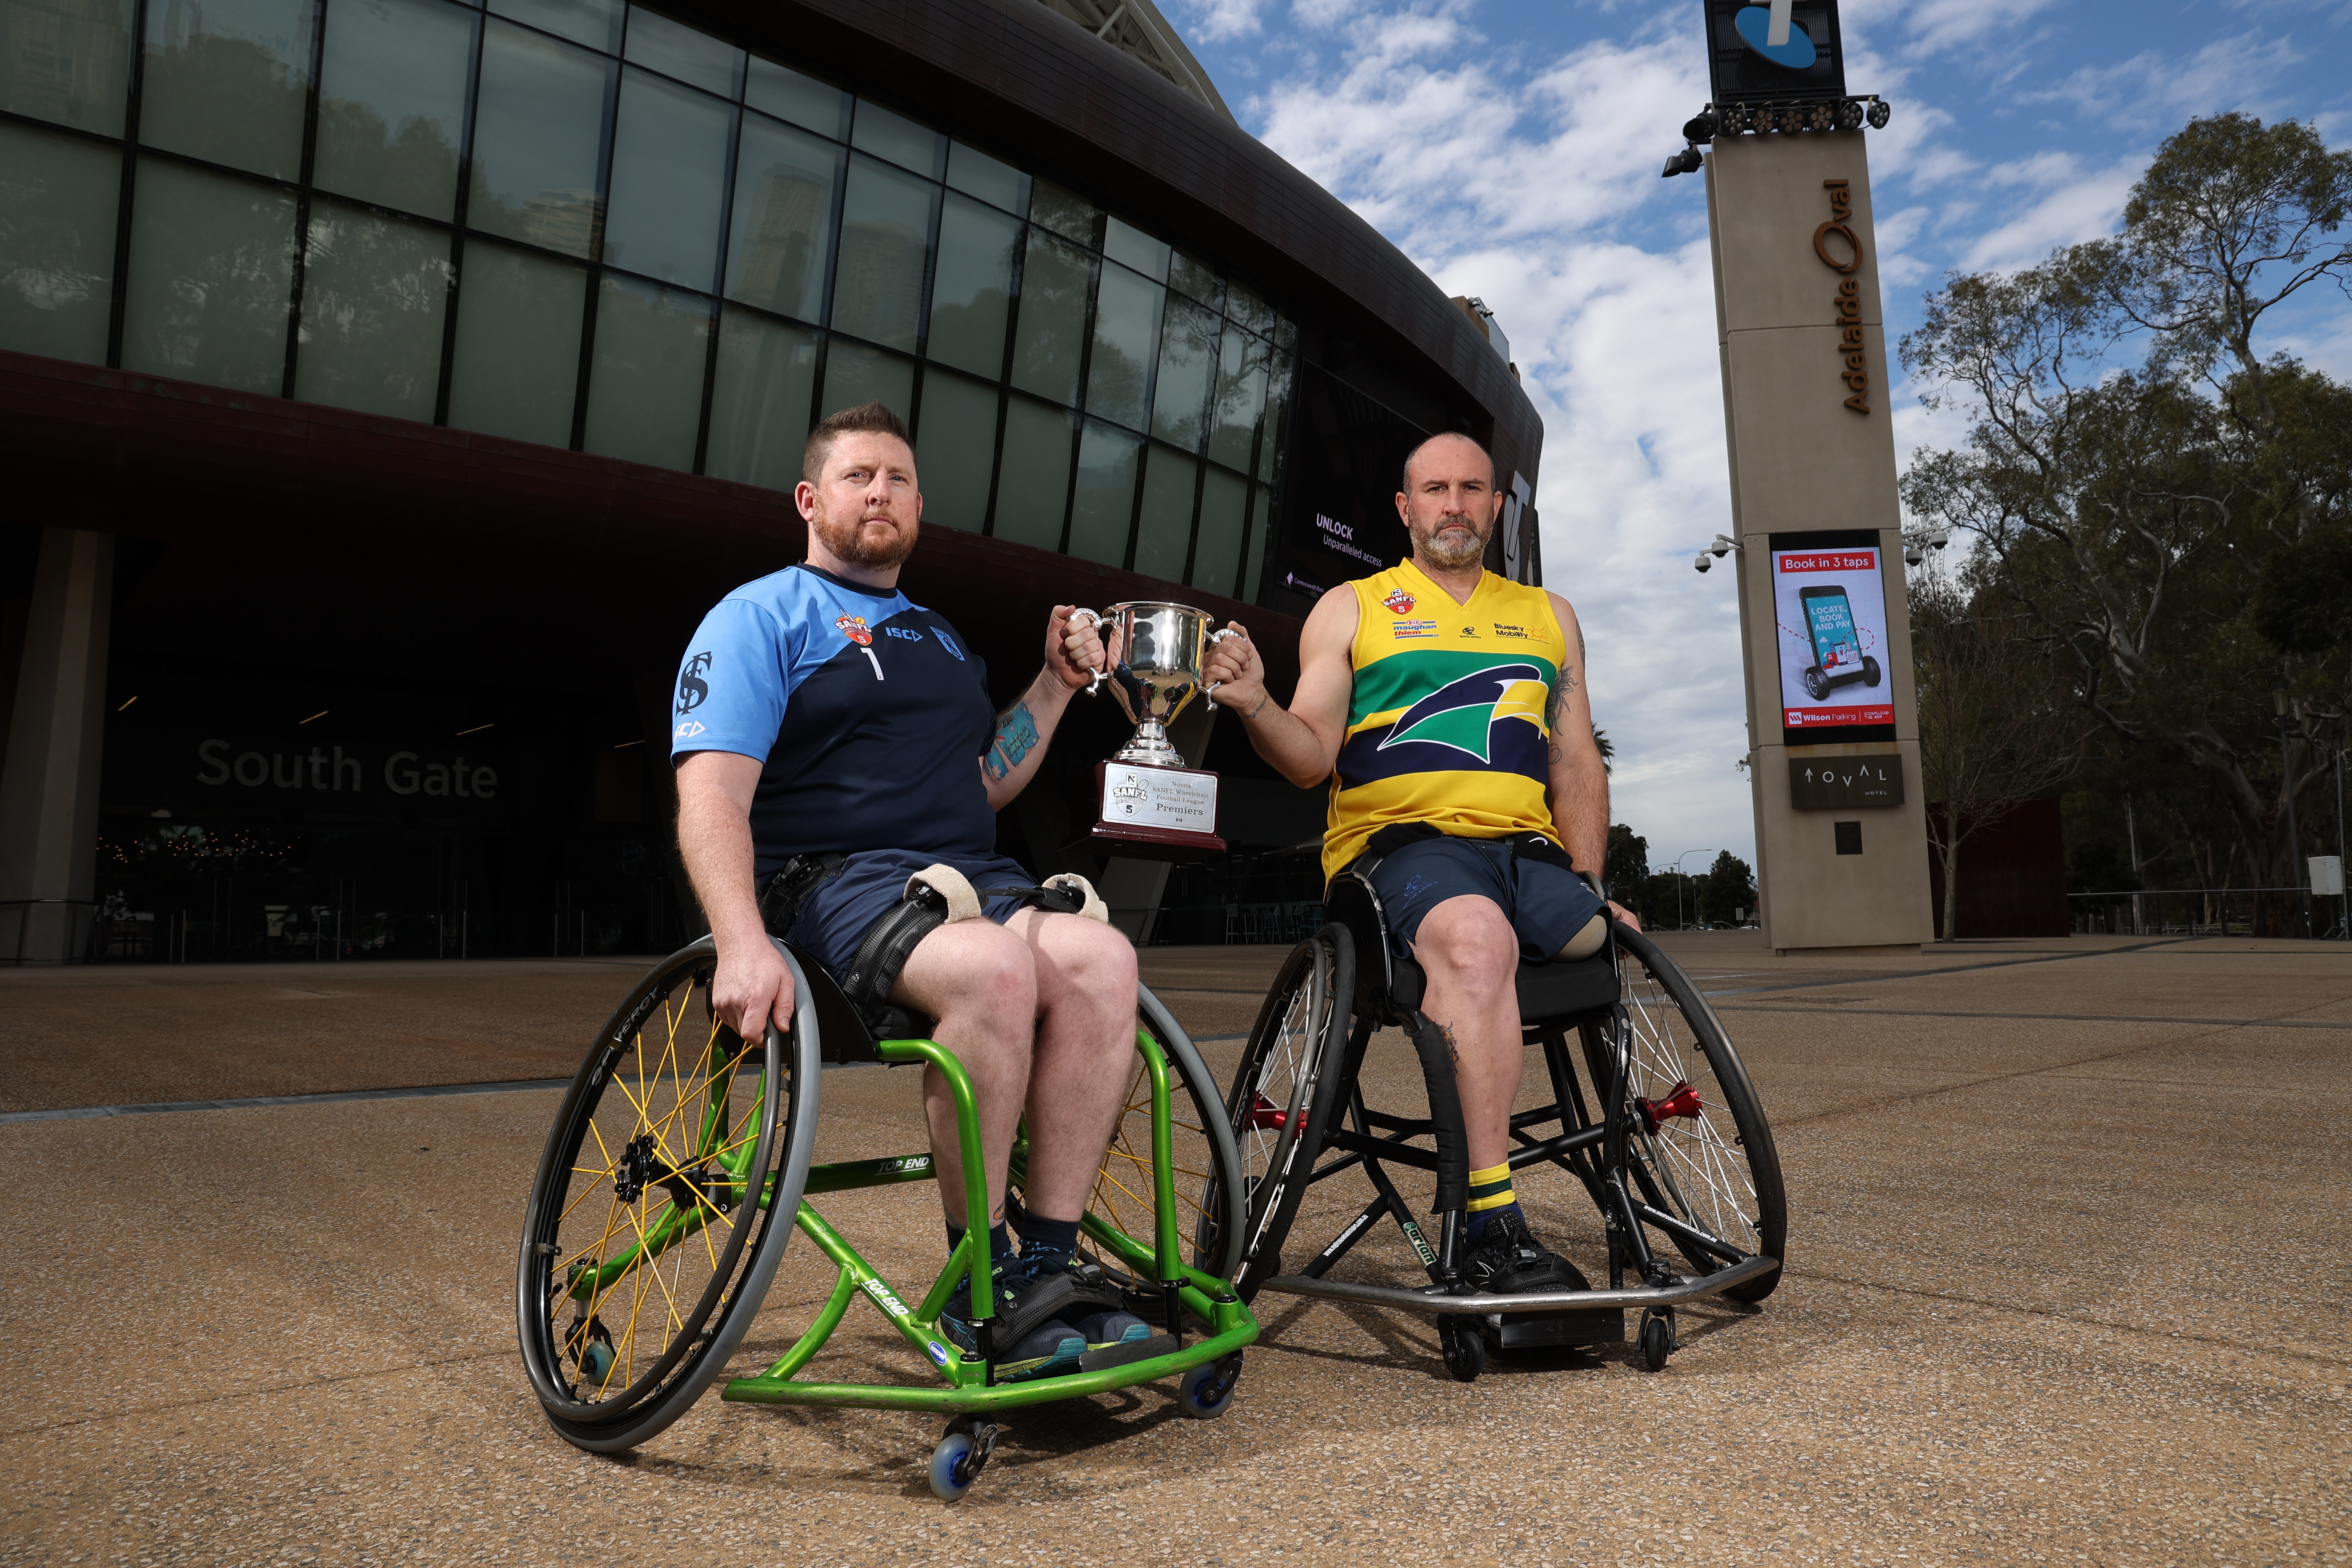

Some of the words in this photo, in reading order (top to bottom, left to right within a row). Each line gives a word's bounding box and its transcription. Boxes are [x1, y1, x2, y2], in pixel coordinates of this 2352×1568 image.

[1813, 178, 1863, 275] Oval
[1834, 277, 1871, 415] Adelaide
[1316, 513, 1353, 540] UNLOCK
[1323, 533, 1362, 559] Unparalleled
[1363, 553, 1382, 567] access
[1785, 558, 1816, 569] Book
[1819, 558, 1830, 567] in
[1833, 557, 1841, 567] 3
[1843, 557, 1868, 569] taps
[1382, 596, 1416, 606] SANFL
[1811, 604, 1847, 615] LOCATE,
[1819, 613, 1844, 622] BOOK
[835, 620, 872, 633] SANFL
[1494, 623, 1524, 632] Bluesky
[1815, 622, 1834, 631] AND
[1836, 620, 1851, 628] PAY
[885, 626, 913, 640] ISC
[1495, 630, 1528, 639] Mobility
[860, 647, 885, 681] 1
[195, 738, 361, 792] South
[383, 750, 498, 799] Gate
[1822, 765, 1886, 787] OVAL
[1113, 787, 1148, 801] SANFL
[1176, 789, 1209, 798] Wheelchair
[1156, 803, 1204, 816] Premiers
[879, 1160, 903, 1173] TOP
[904, 1157, 930, 1170] END
[992, 1266, 1003, 1277] SICS
[864, 1278, 890, 1295] TOP
[882, 1297, 909, 1315] END
[929, 1345, 946, 1360] INVACARE
